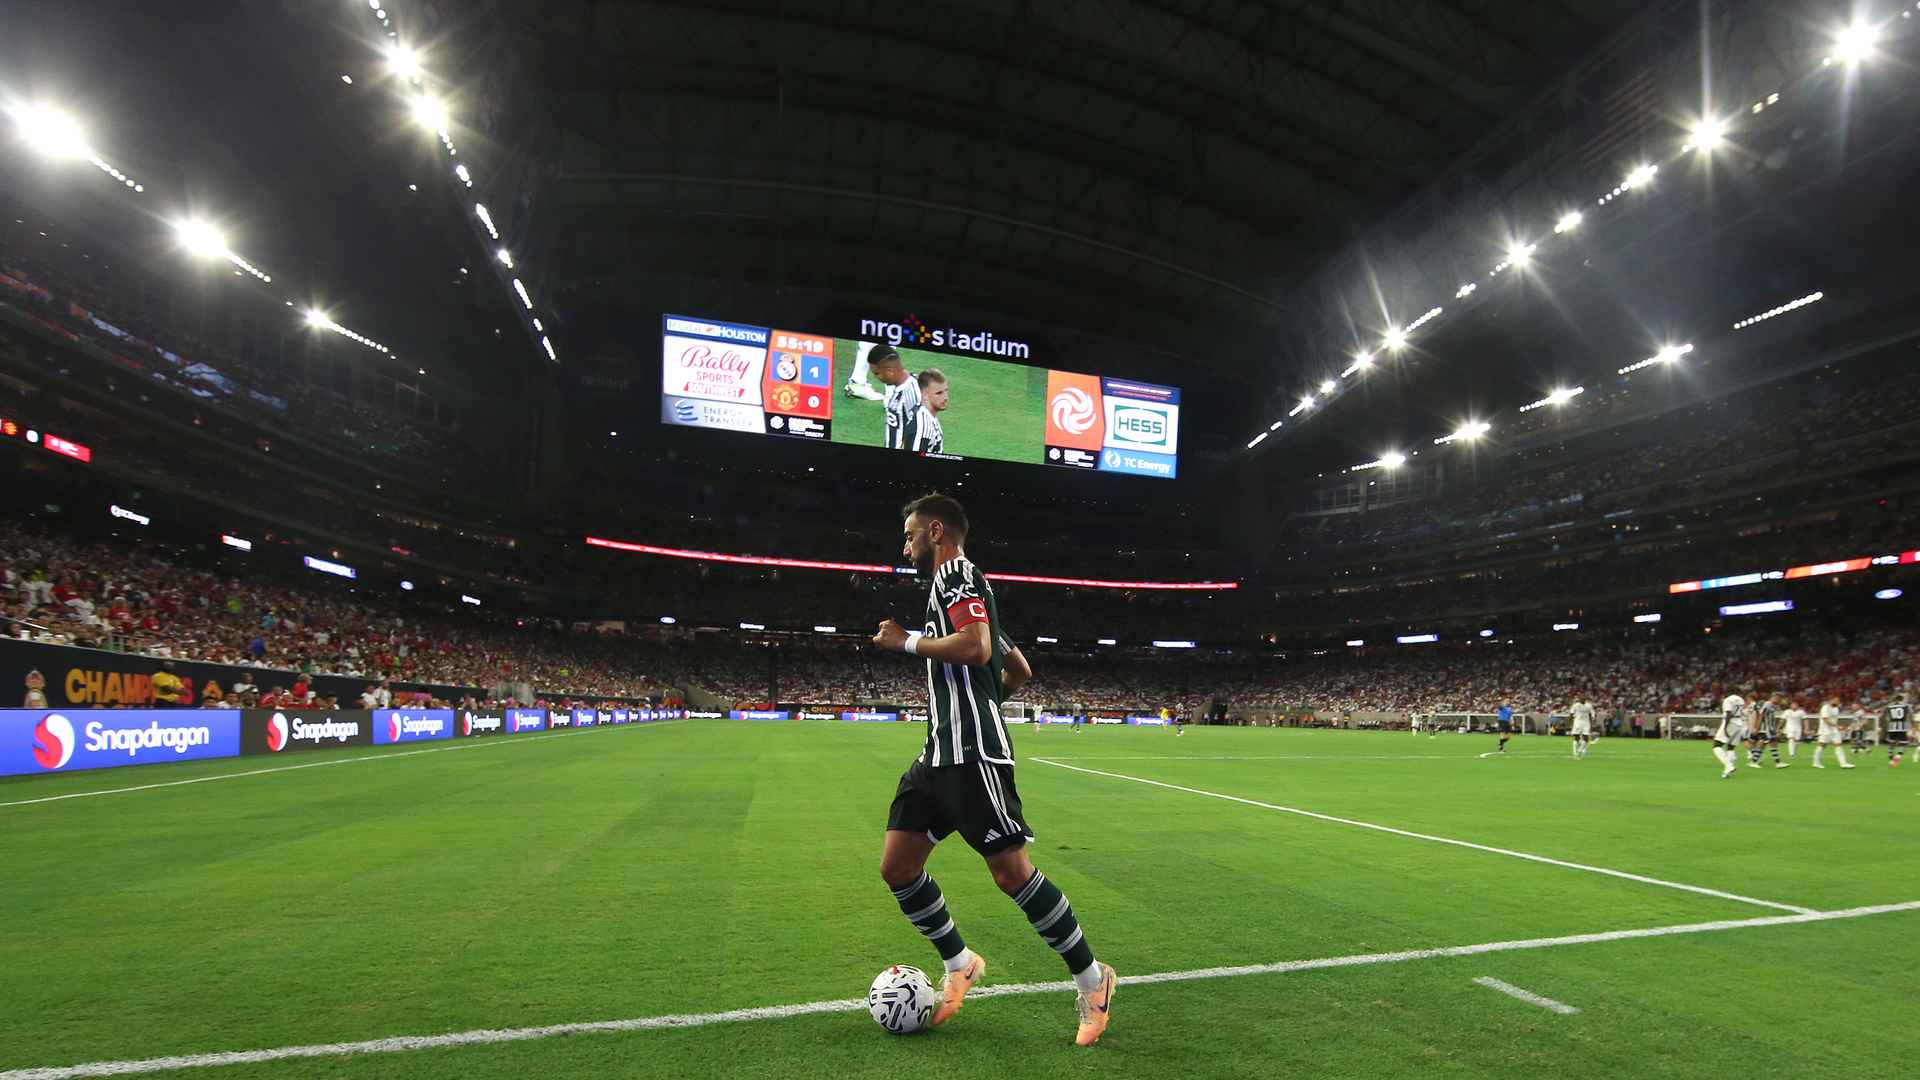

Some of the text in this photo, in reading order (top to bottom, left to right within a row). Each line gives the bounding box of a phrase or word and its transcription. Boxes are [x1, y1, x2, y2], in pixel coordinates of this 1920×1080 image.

[719, 326, 766, 343] HOUSTON
[861, 319, 1029, 359] nrg stadium
[681, 344, 751, 380] Bally
[696, 371, 734, 385] SPORTS
[810, 366, 820, 379] 1
[1118, 416, 1163, 435] HESS
[1123, 456, 1137, 469] TC
[968, 602, 986, 618] C
[291, 717, 359, 744] Snapdragon
[402, 716, 444, 736] Snapdragon
[84, 720, 210, 757] Snapdragon
